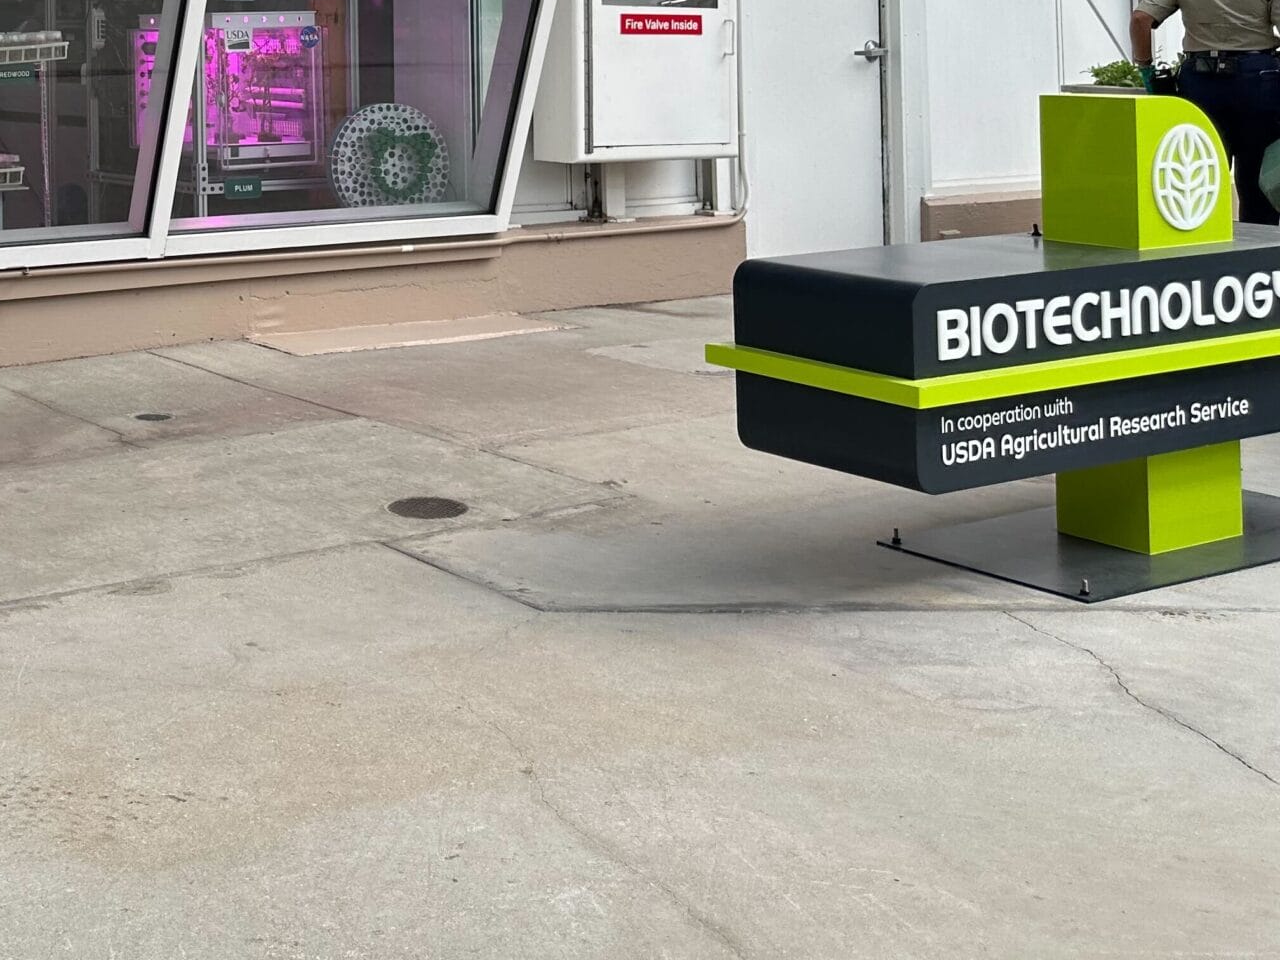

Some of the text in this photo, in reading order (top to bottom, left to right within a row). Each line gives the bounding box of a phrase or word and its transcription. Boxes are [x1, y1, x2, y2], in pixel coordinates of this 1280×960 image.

[625, 18, 698, 31] Fire Valve Inside
[226, 30, 250, 39] USDA
[0, 70, 30, 78] REDWOOD
[234, 184, 253, 192] PLUM
[941, 396, 1073, 434] In cooperation with
[942, 396, 1249, 466] USDA Agricultural Research Service
